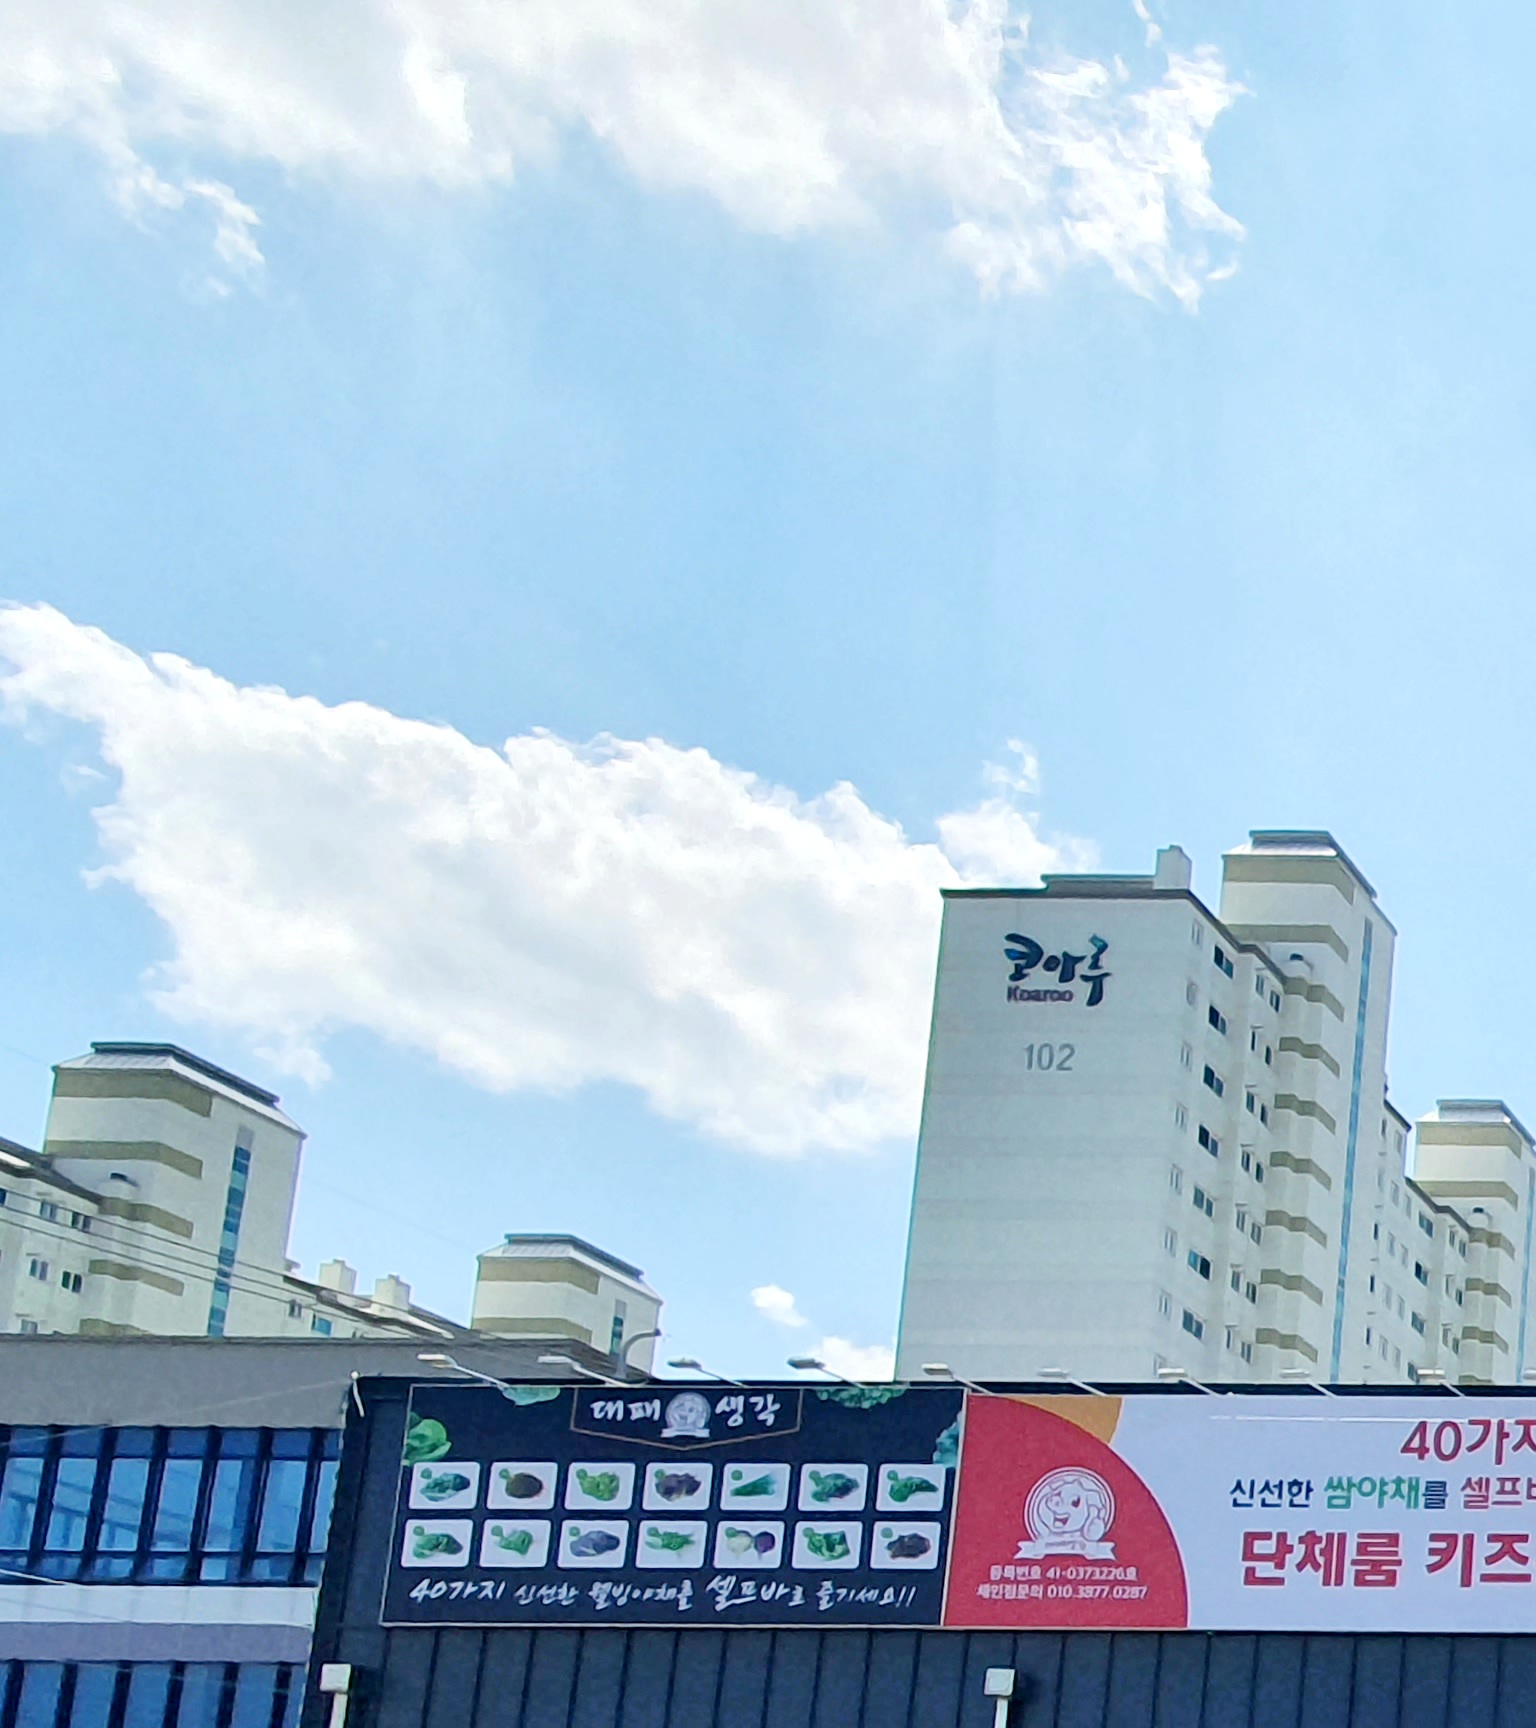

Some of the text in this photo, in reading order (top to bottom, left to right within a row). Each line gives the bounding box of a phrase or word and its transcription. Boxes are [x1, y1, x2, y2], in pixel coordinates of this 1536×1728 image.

[1003, 932, 1113, 1007] 코아루
[1023, 1042, 1076, 1072] 102
[589, 1392, 782, 1428] 대패 생각
[1229, 1477, 1315, 1511] 신선한
[1322, 1475, 1449, 1512] 쌈야채를
[1239, 1531, 1403, 1591] 단체룸
